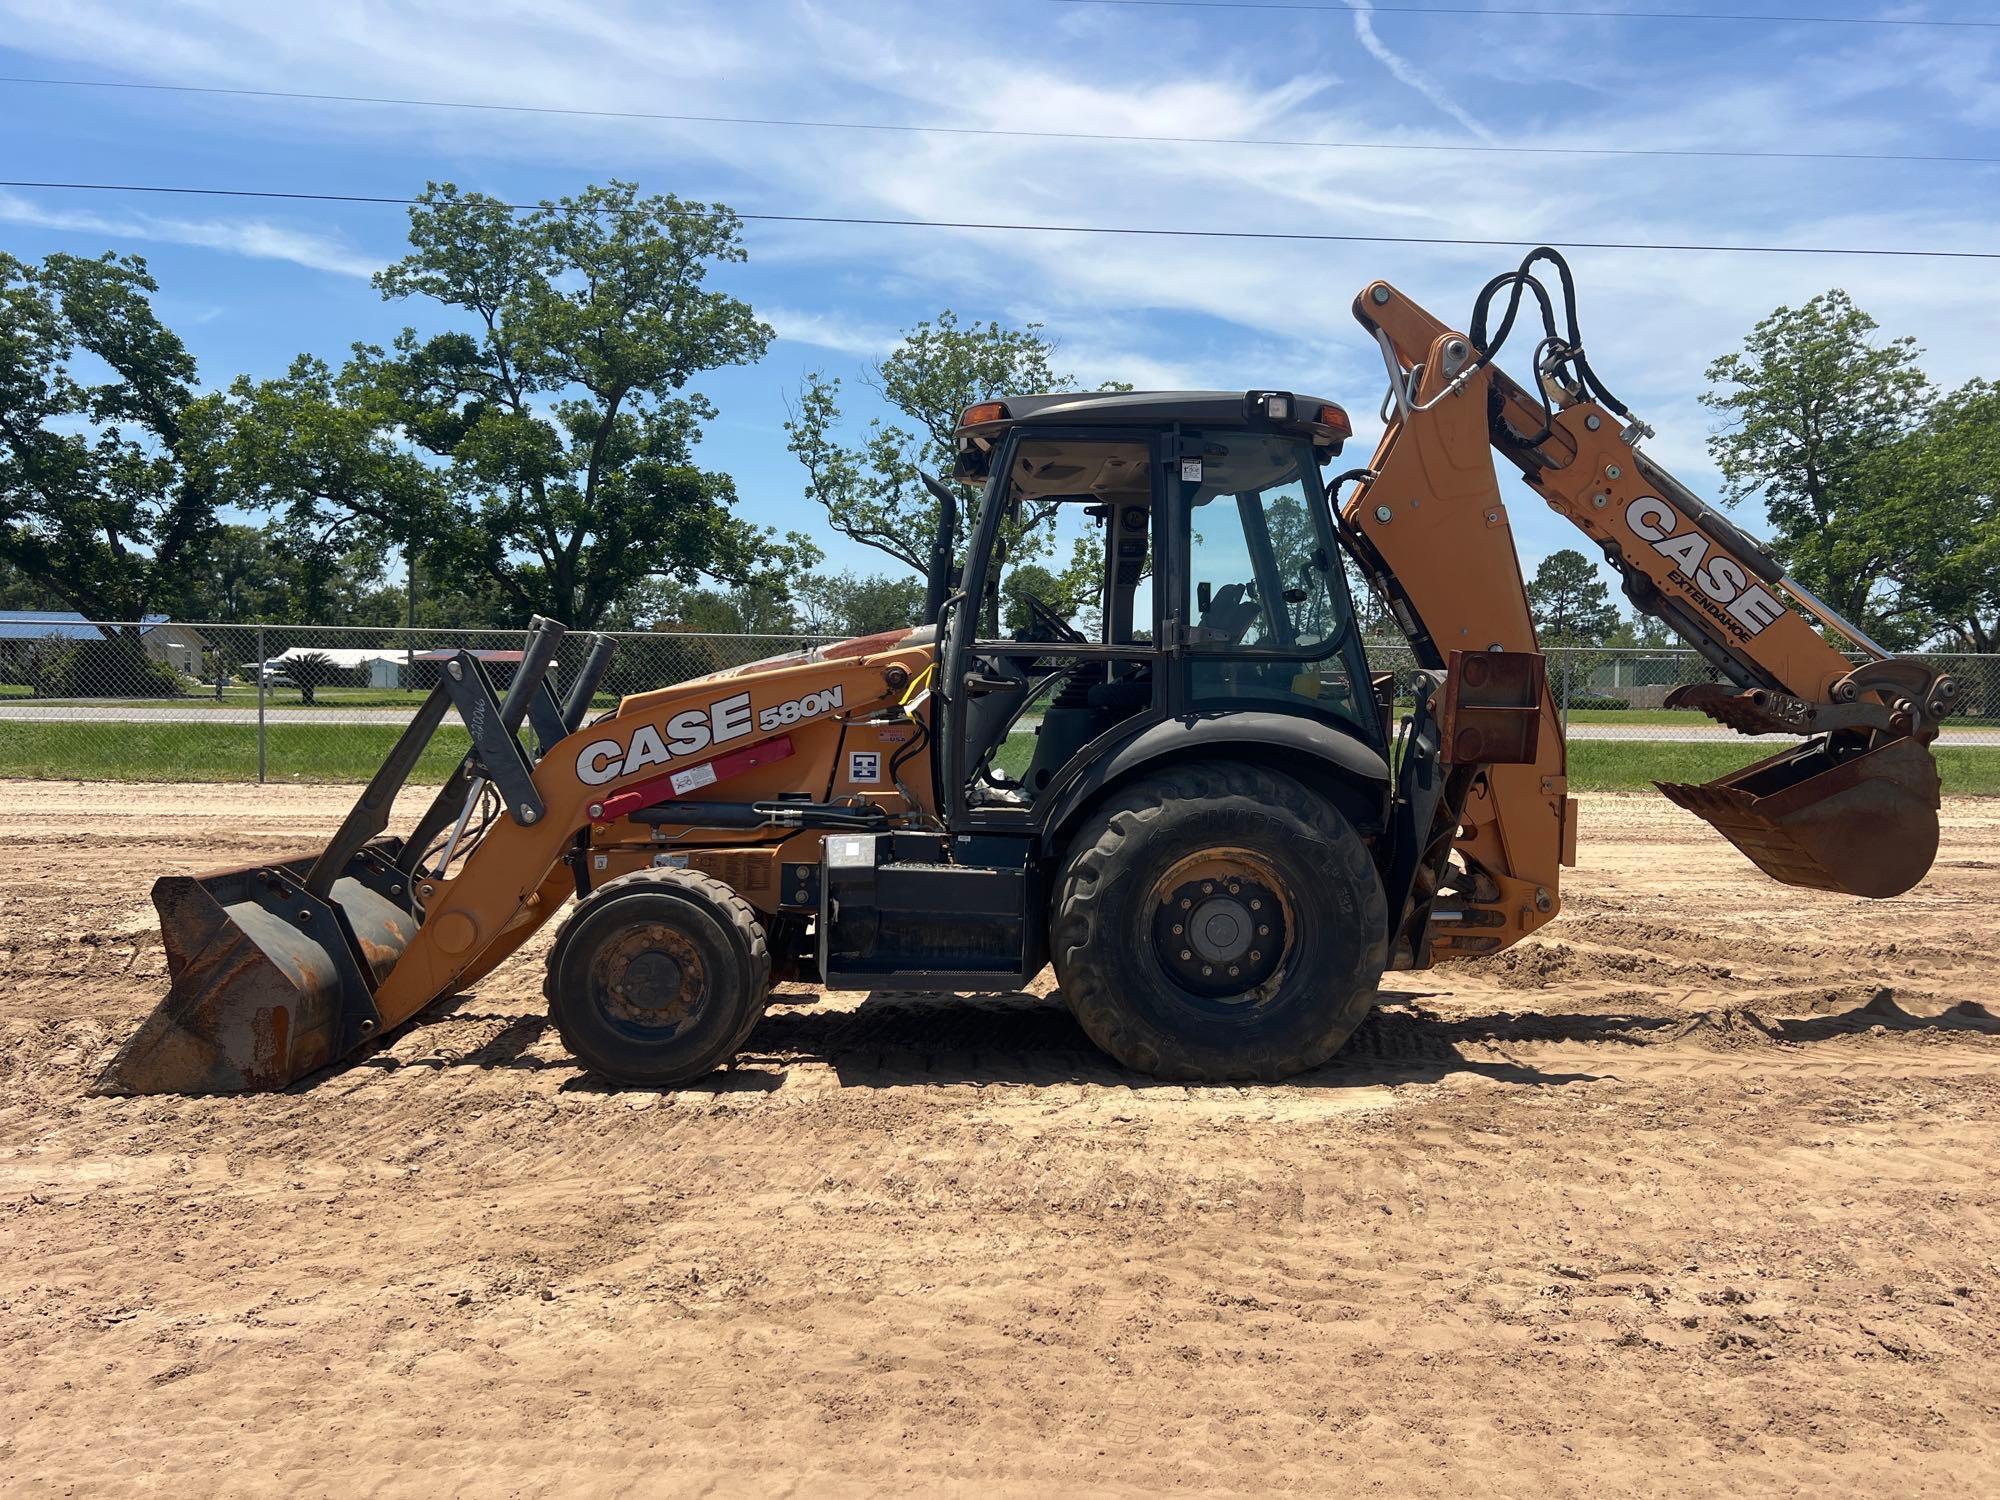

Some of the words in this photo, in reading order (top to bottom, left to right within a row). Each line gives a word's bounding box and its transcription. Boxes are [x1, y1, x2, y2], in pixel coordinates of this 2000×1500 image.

[1625, 496, 1787, 636] CASE
[1667, 569, 1753, 644] EXTENDAHOE
[575, 691, 753, 786] CASE
[758, 684, 844, 732] 580N
